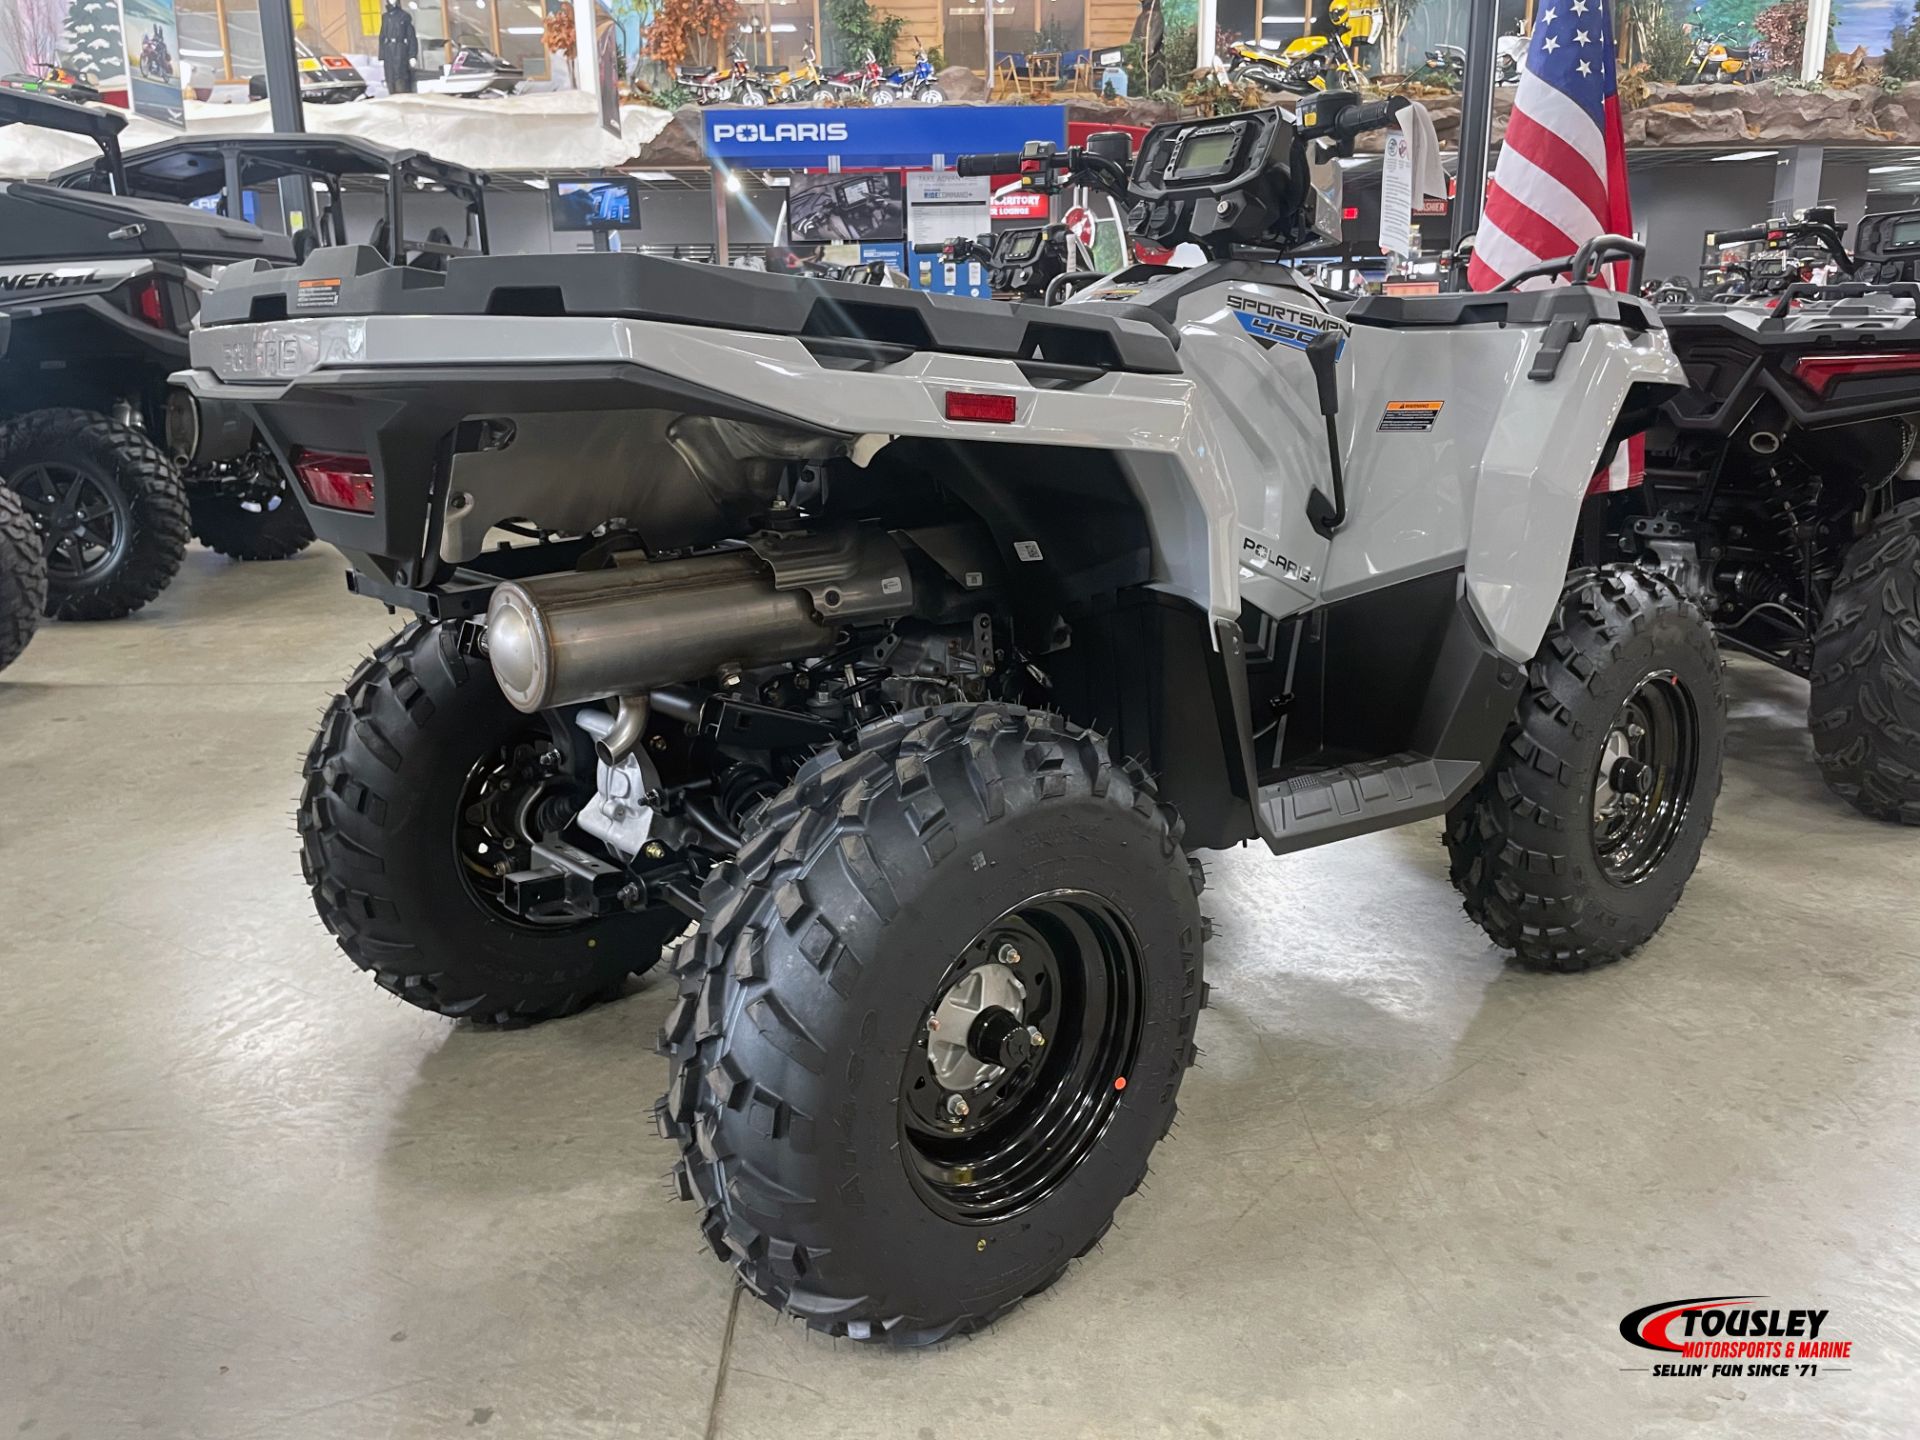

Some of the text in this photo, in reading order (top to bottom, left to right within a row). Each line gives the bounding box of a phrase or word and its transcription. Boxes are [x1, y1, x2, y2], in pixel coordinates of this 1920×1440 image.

[713, 123, 848, 142] POLARIS
[1226, 295, 1352, 338] SPORTSMAN
[1243, 537, 1311, 583] POLARIS
